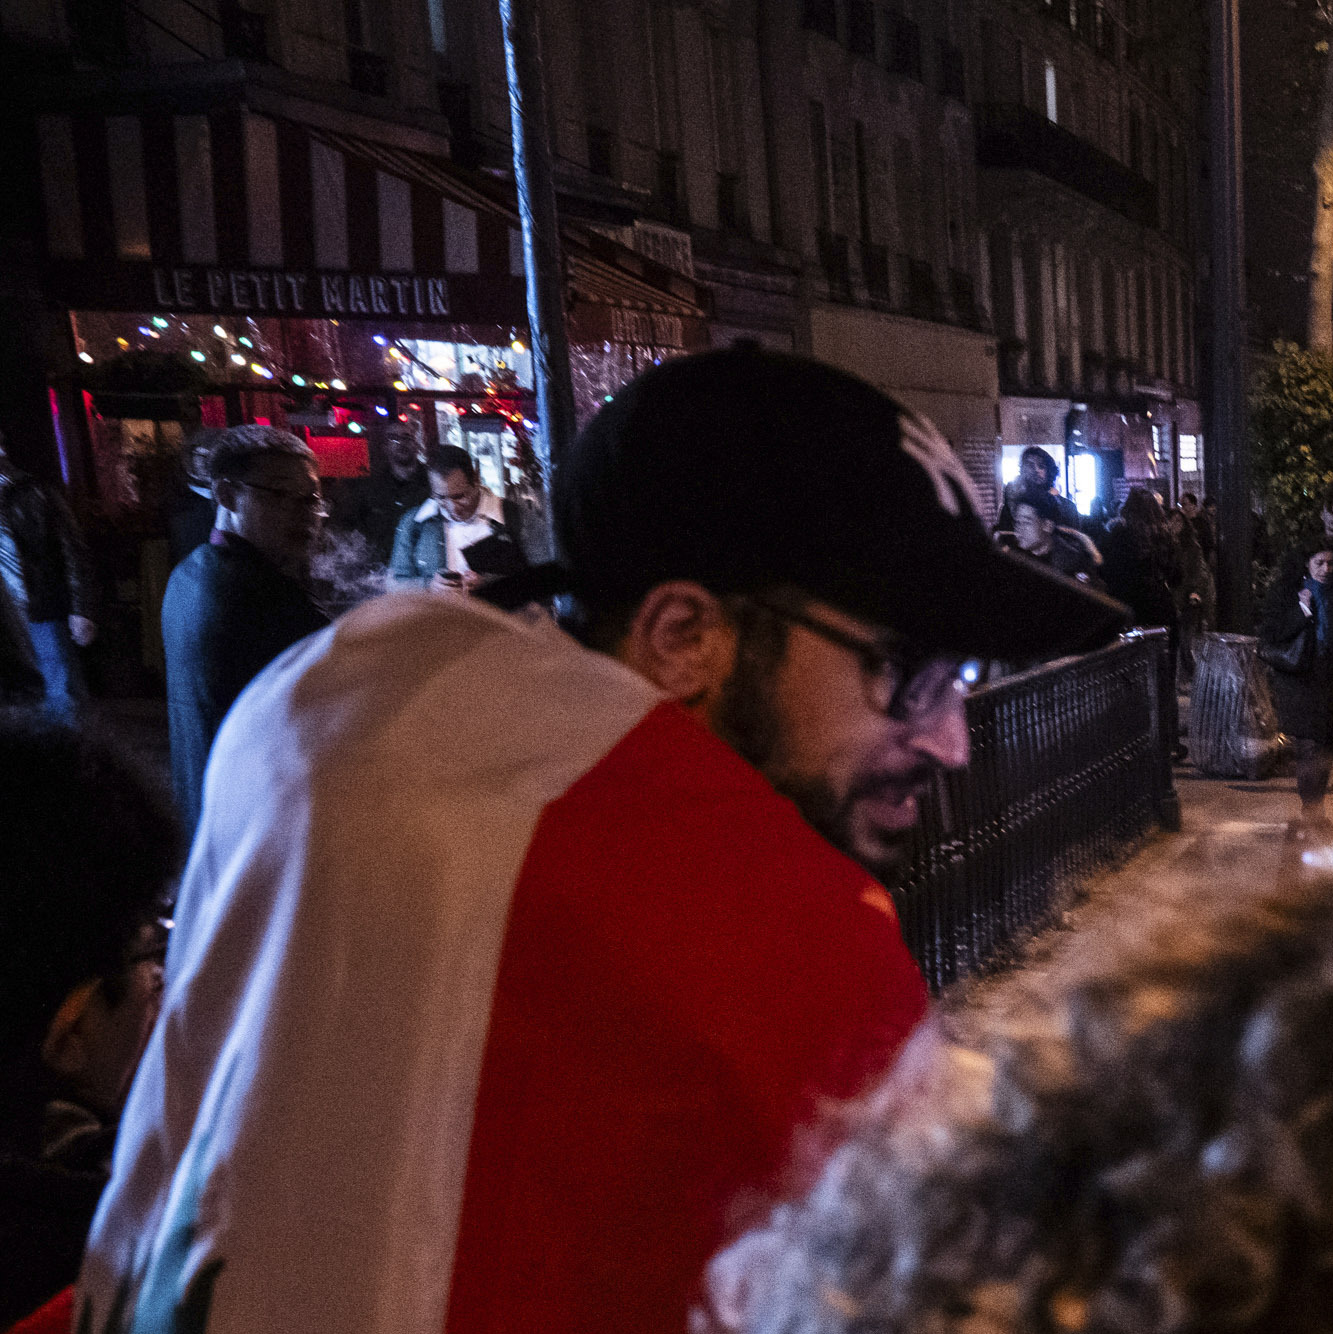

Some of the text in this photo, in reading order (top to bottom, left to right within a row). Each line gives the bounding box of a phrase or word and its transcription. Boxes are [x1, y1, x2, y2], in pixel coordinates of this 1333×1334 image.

[154, 267, 449, 315] LE PETIT MARTIN
